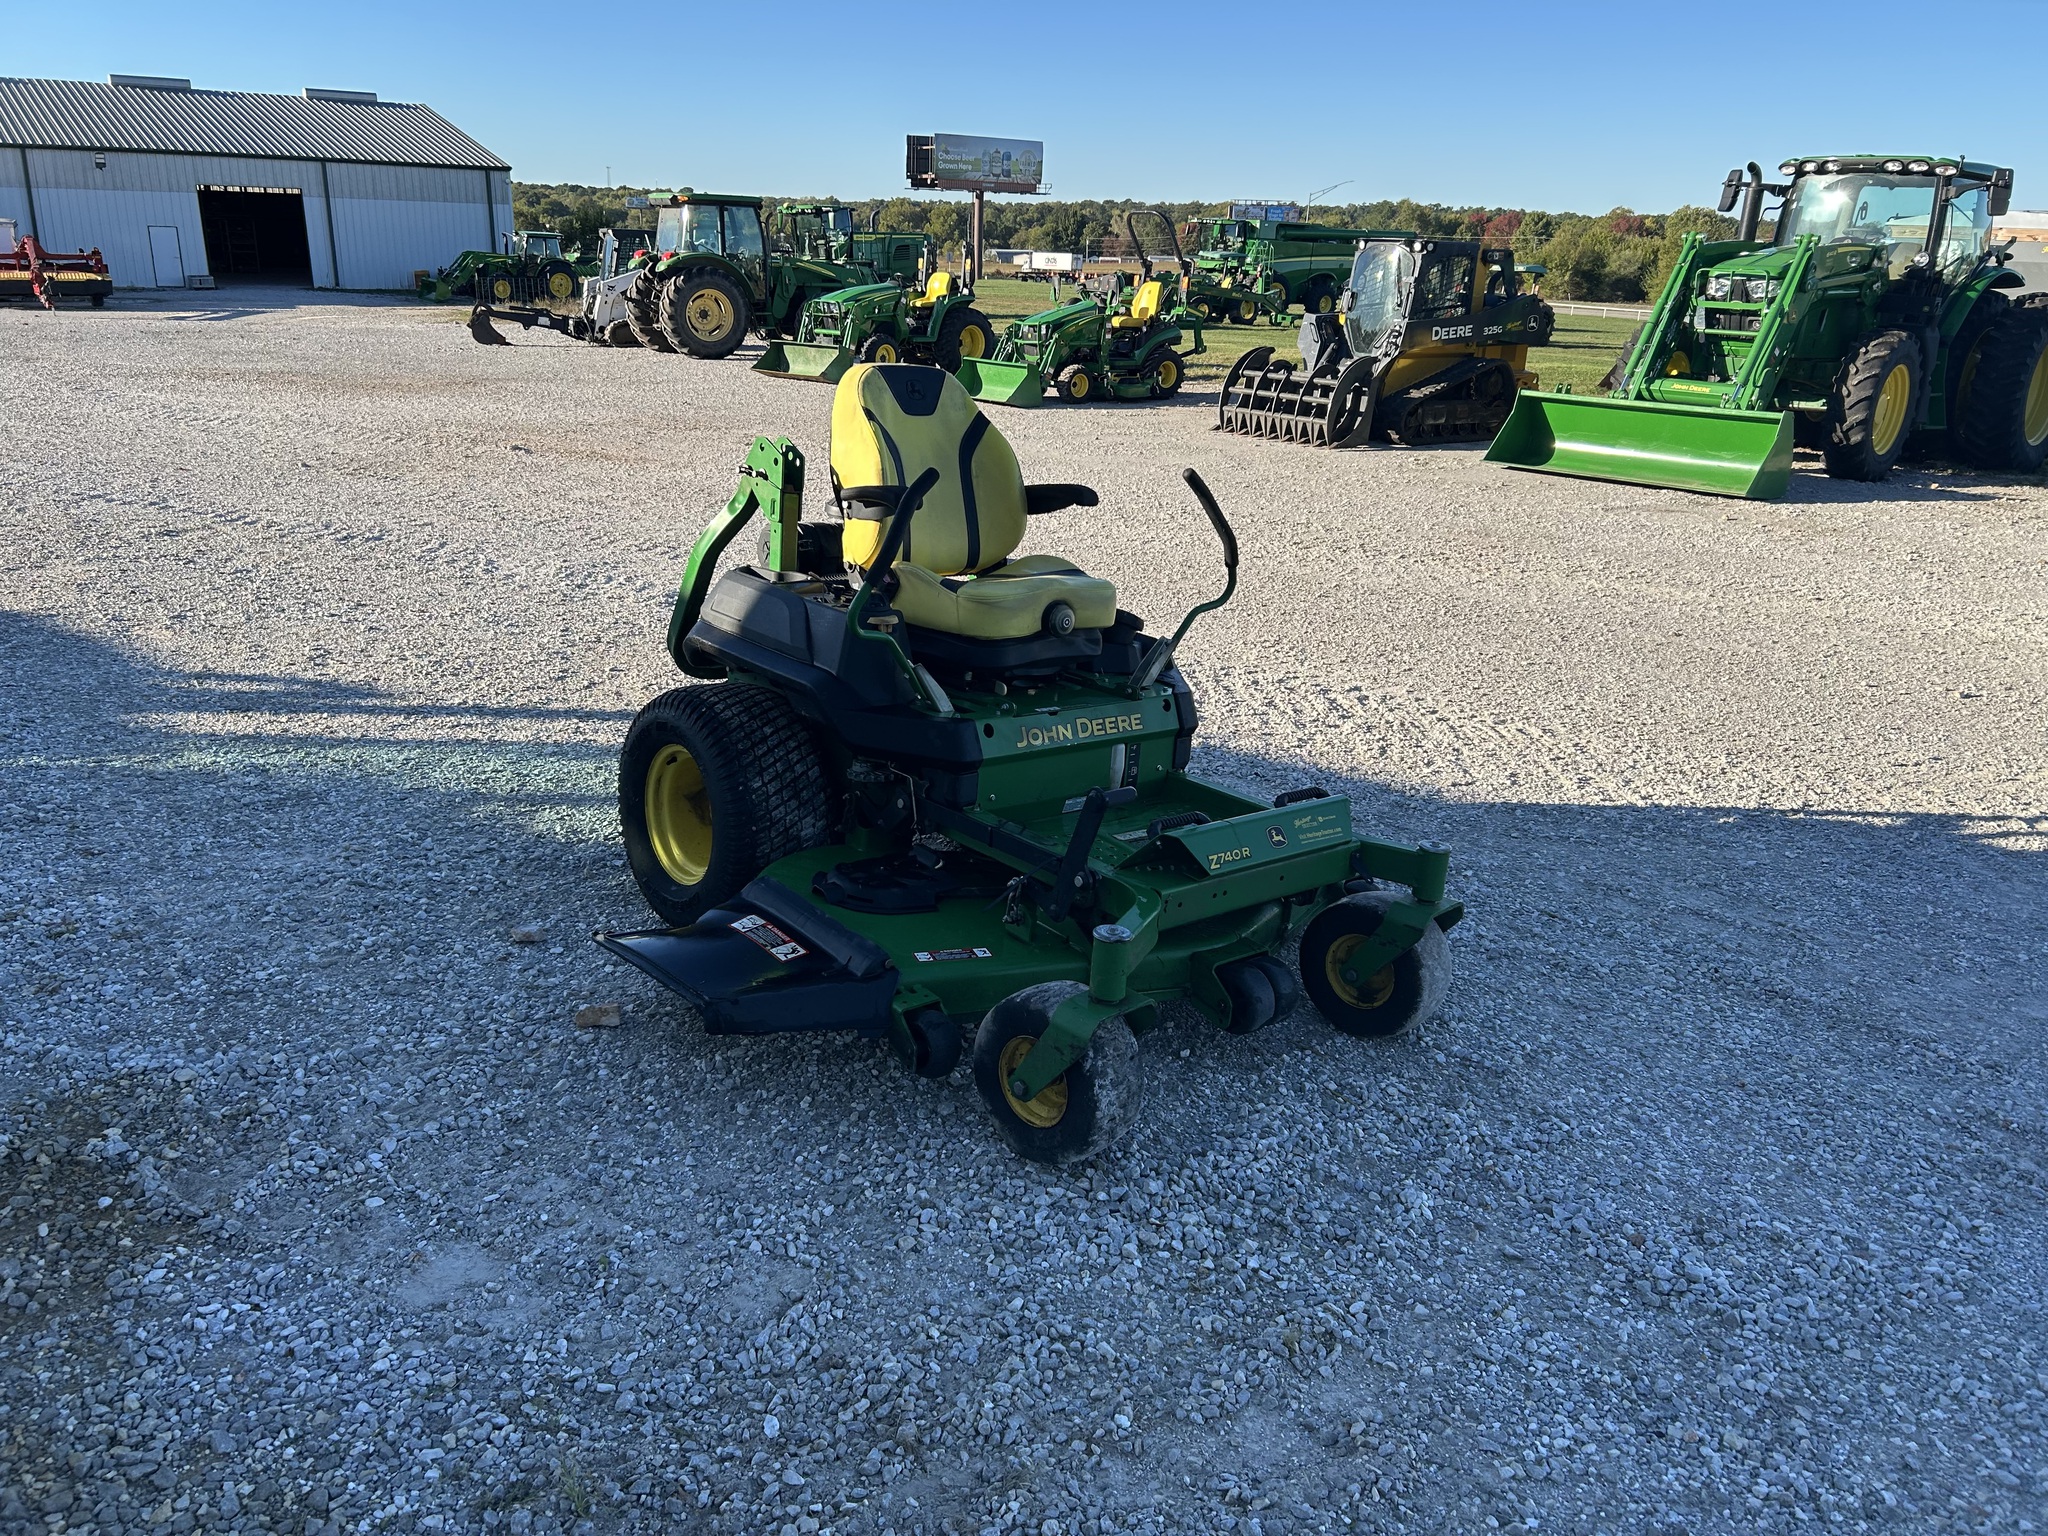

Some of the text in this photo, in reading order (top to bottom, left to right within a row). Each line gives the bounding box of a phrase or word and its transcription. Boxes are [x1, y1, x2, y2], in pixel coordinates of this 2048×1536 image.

[938, 151, 976, 162] Choose Beer
[937, 160, 973, 171] Grown Here
[1432, 324, 1473, 341] DEERE
[1482, 325, 1503, 336] 325G
[1671, 382, 1712, 393] JOHN DEERE
[1016, 713, 1144, 748] JOHN DEERE
